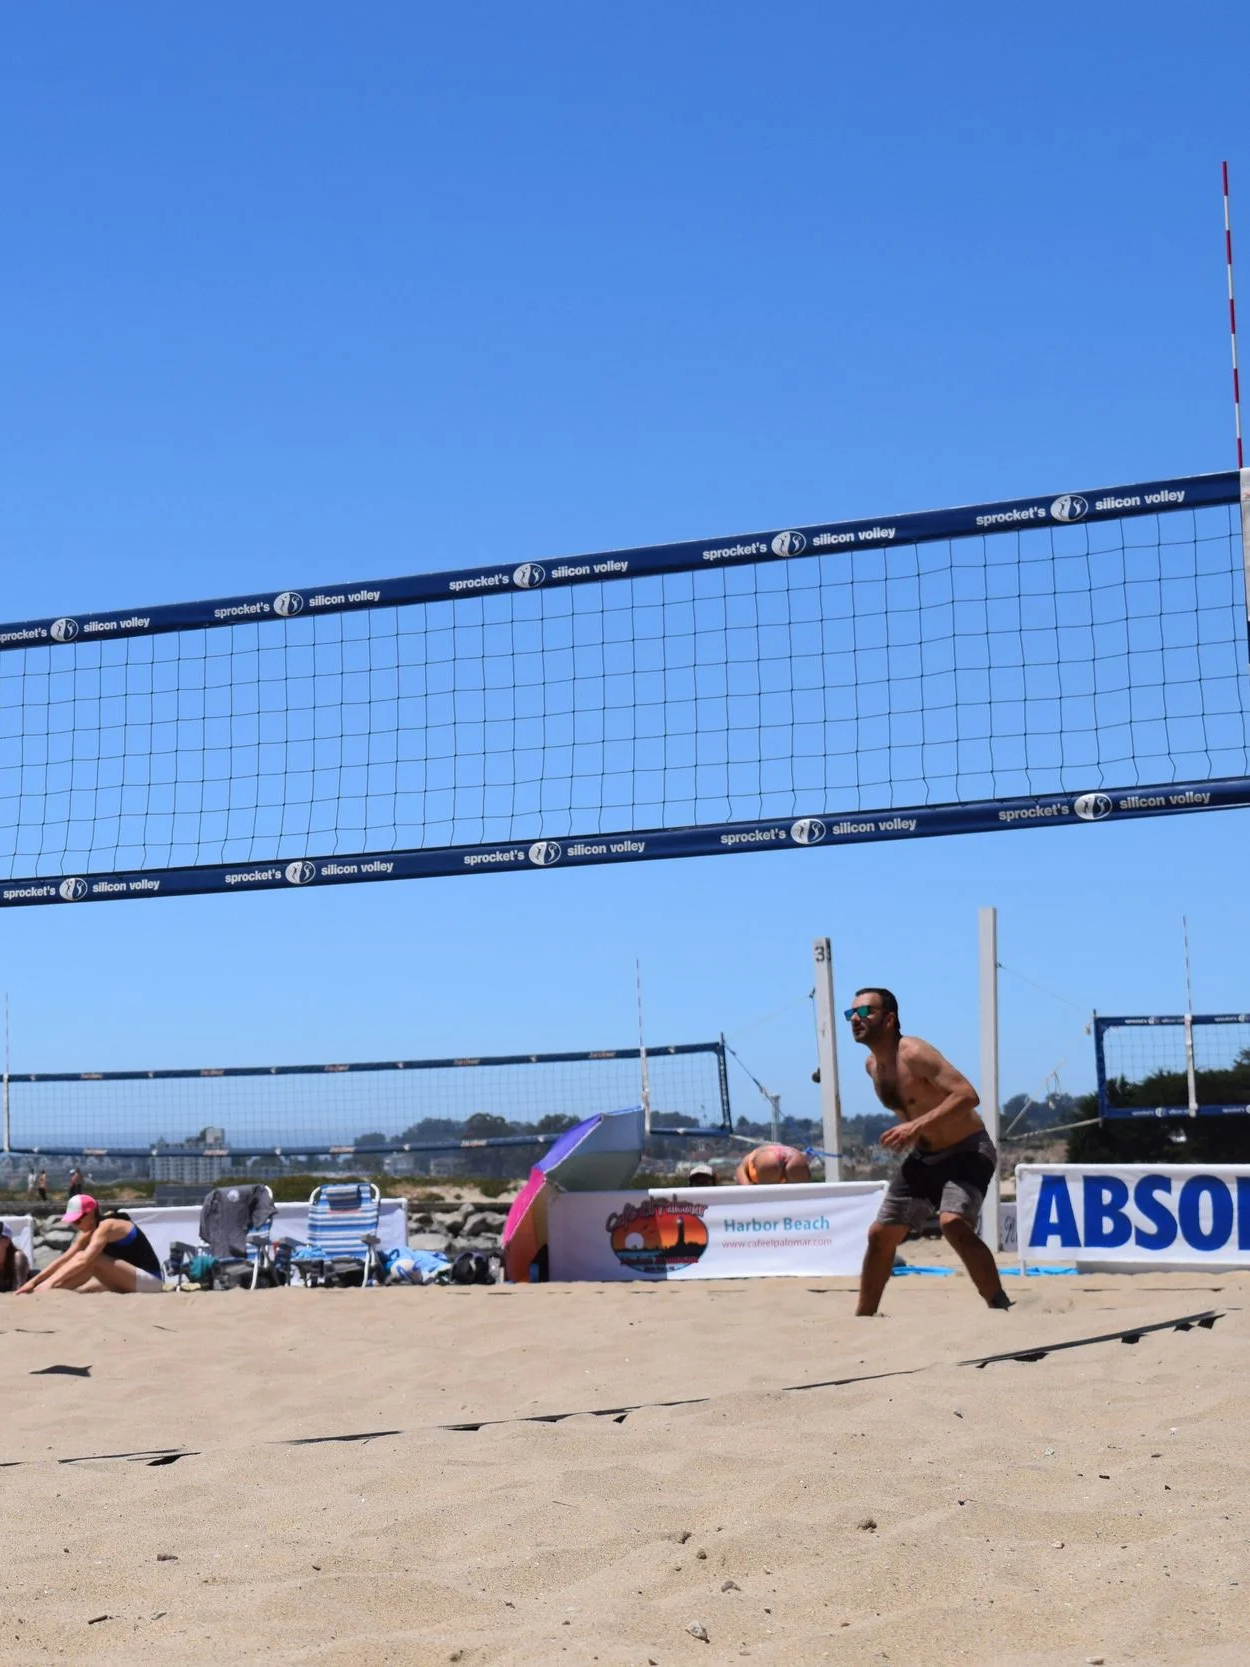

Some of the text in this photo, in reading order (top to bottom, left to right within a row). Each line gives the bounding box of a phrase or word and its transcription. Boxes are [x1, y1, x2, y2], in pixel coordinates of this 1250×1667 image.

[976, 490, 1185, 526] sprocket's silicon volley
[703, 527, 895, 562] sprocket's silicon volley
[449, 560, 628, 591] sprocket's silicon volley
[214, 590, 380, 619] sprocket's silicon volley
[84, 621, 117, 632] silicon
[120, 617, 150, 630] volley
[998, 791, 1210, 822] sprocket's silicon volley
[720, 817, 916, 845] sprocket's silicon volley
[464, 840, 645, 865] sprocket's silicon volley
[225, 861, 393, 884] sprocket's silicon volley
[4, 879, 160, 899] sprocket's silicon volley
[814, 945, 825, 962] 3
[723, 1216, 830, 1233] Harbor Beach
